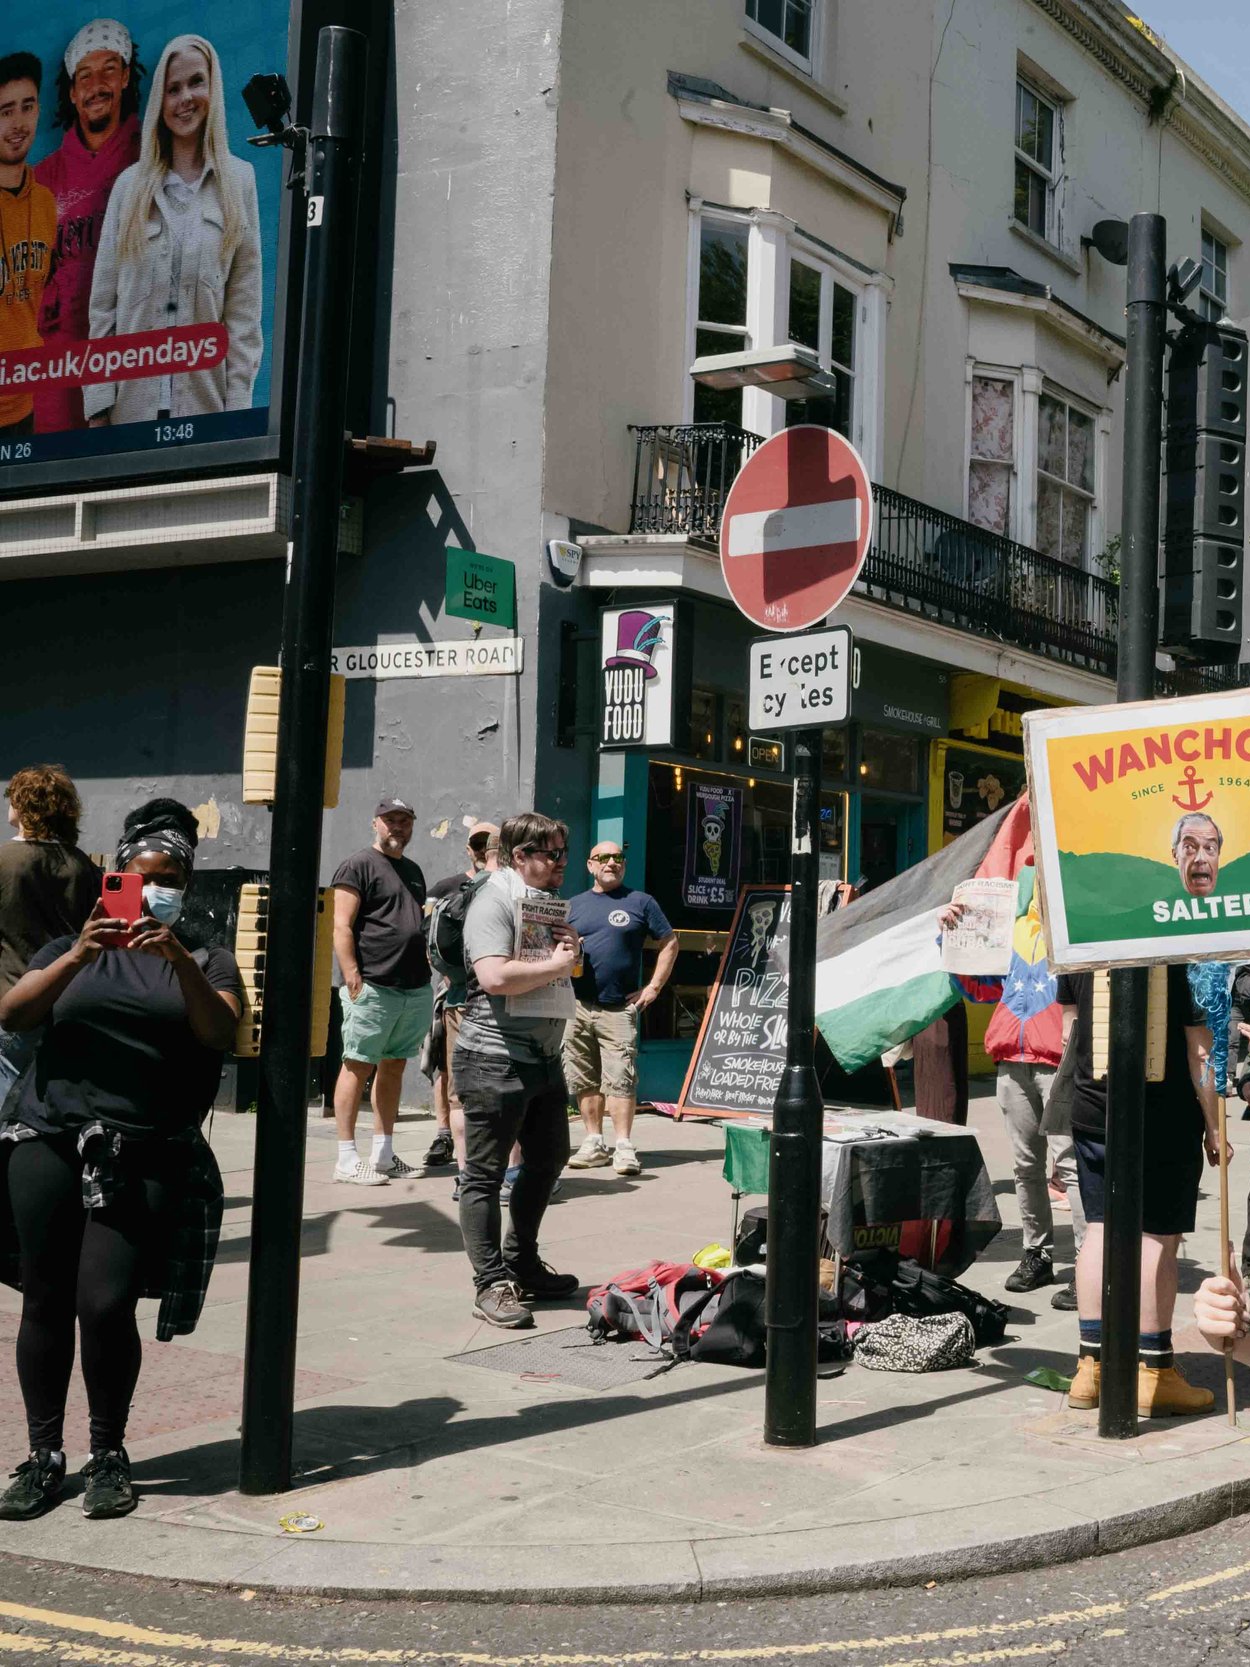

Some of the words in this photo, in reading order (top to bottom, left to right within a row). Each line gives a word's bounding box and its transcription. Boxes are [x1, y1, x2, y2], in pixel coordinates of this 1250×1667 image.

[0, 336, 218, 386] i.ac.uk/opendays
[154, 423, 194, 442] 13:48
[15, 443, 32, 459] 26
[566, 548, 581, 560] SPY
[464, 571, 498, 594] Uber
[464, 590, 497, 614] Eats
[346, 650, 457, 671] GLOUCESTER
[467, 646, 513, 664] ROAD
[760, 644, 839, 679] Ecept
[604, 668, 644, 705] VUDU
[763, 683, 834, 717] cyles
[604, 703, 643, 741] FOOD
[883, 704, 923, 725] SMOKEHOUSE
[752, 746, 780, 763] OPEN
[1131, 783, 1165, 800] SINCE
[1218, 776, 1250, 788] 1964
[687, 884, 706, 894] SLICE
[710, 886, 724, 904] £5
[687, 894, 709, 905] DRINK
[521, 903, 538, 914] FIGHT
[719, 1010, 763, 1030] WHOLE
[713, 1030, 726, 1046] OR
[727, 1030, 741, 1047] BY
[741, 1031, 760, 1047] THE
[710, 1069, 754, 1088] LOADED
[754, 1075, 781, 1092] FRIE
[853, 1227, 898, 1248] VICTO
